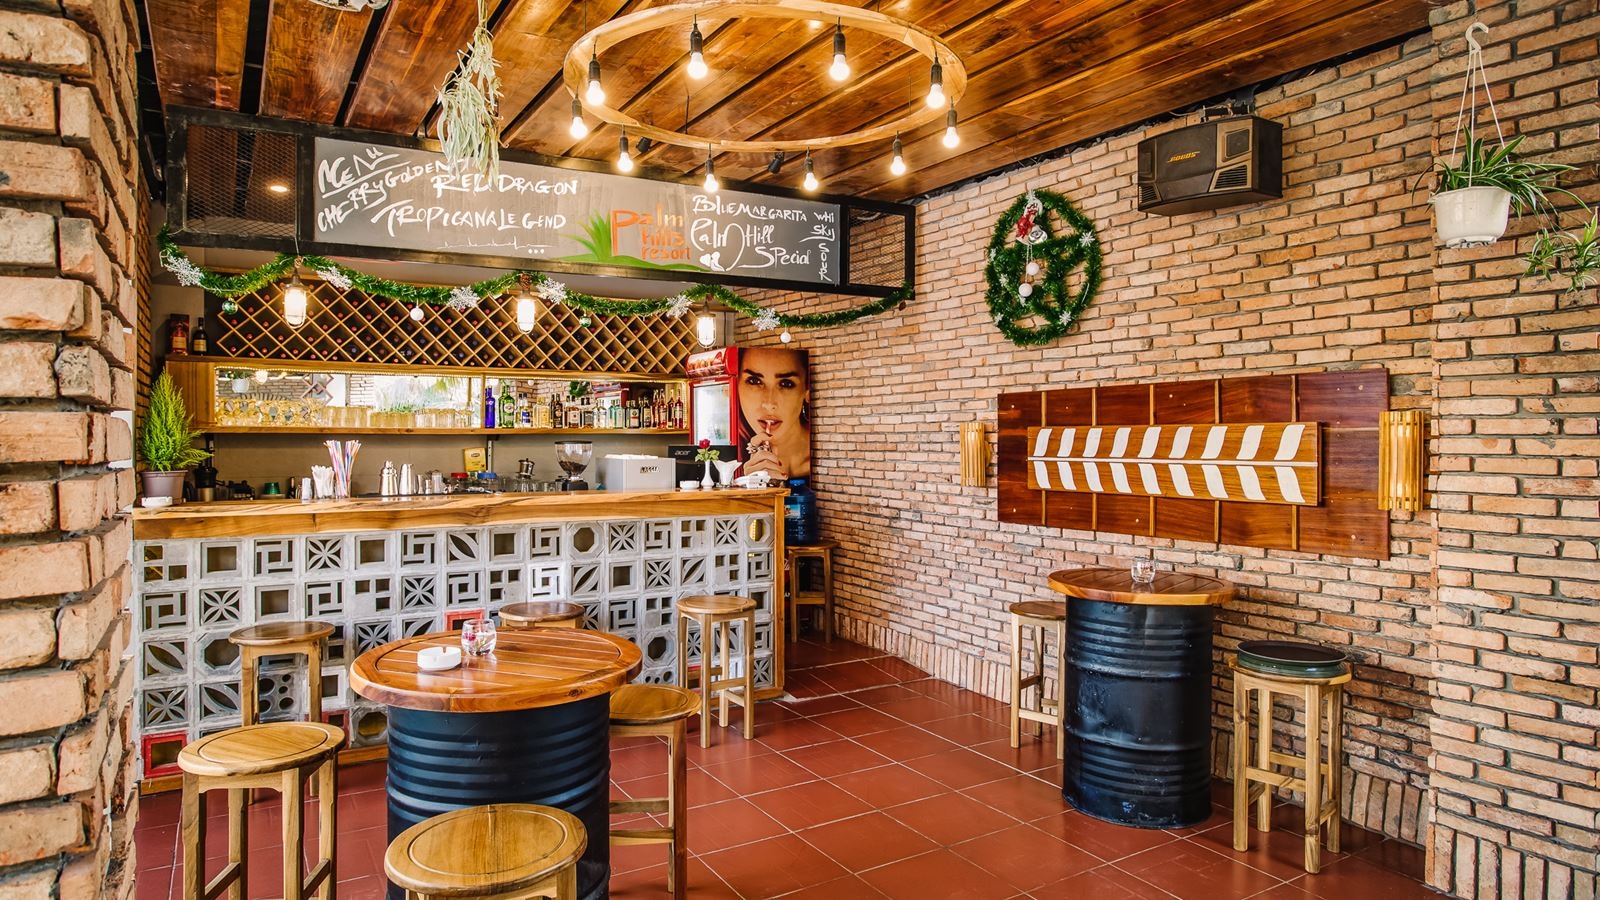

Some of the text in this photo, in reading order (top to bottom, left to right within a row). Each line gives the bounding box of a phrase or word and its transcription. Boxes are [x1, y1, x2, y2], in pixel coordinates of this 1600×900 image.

[498, 174, 578, 195] DRAGON
[733, 203, 807, 222] MARGARITA
[612, 203, 683, 256] Palm
[745, 224, 775, 247] Hill
[641, 246, 690, 260] resort
